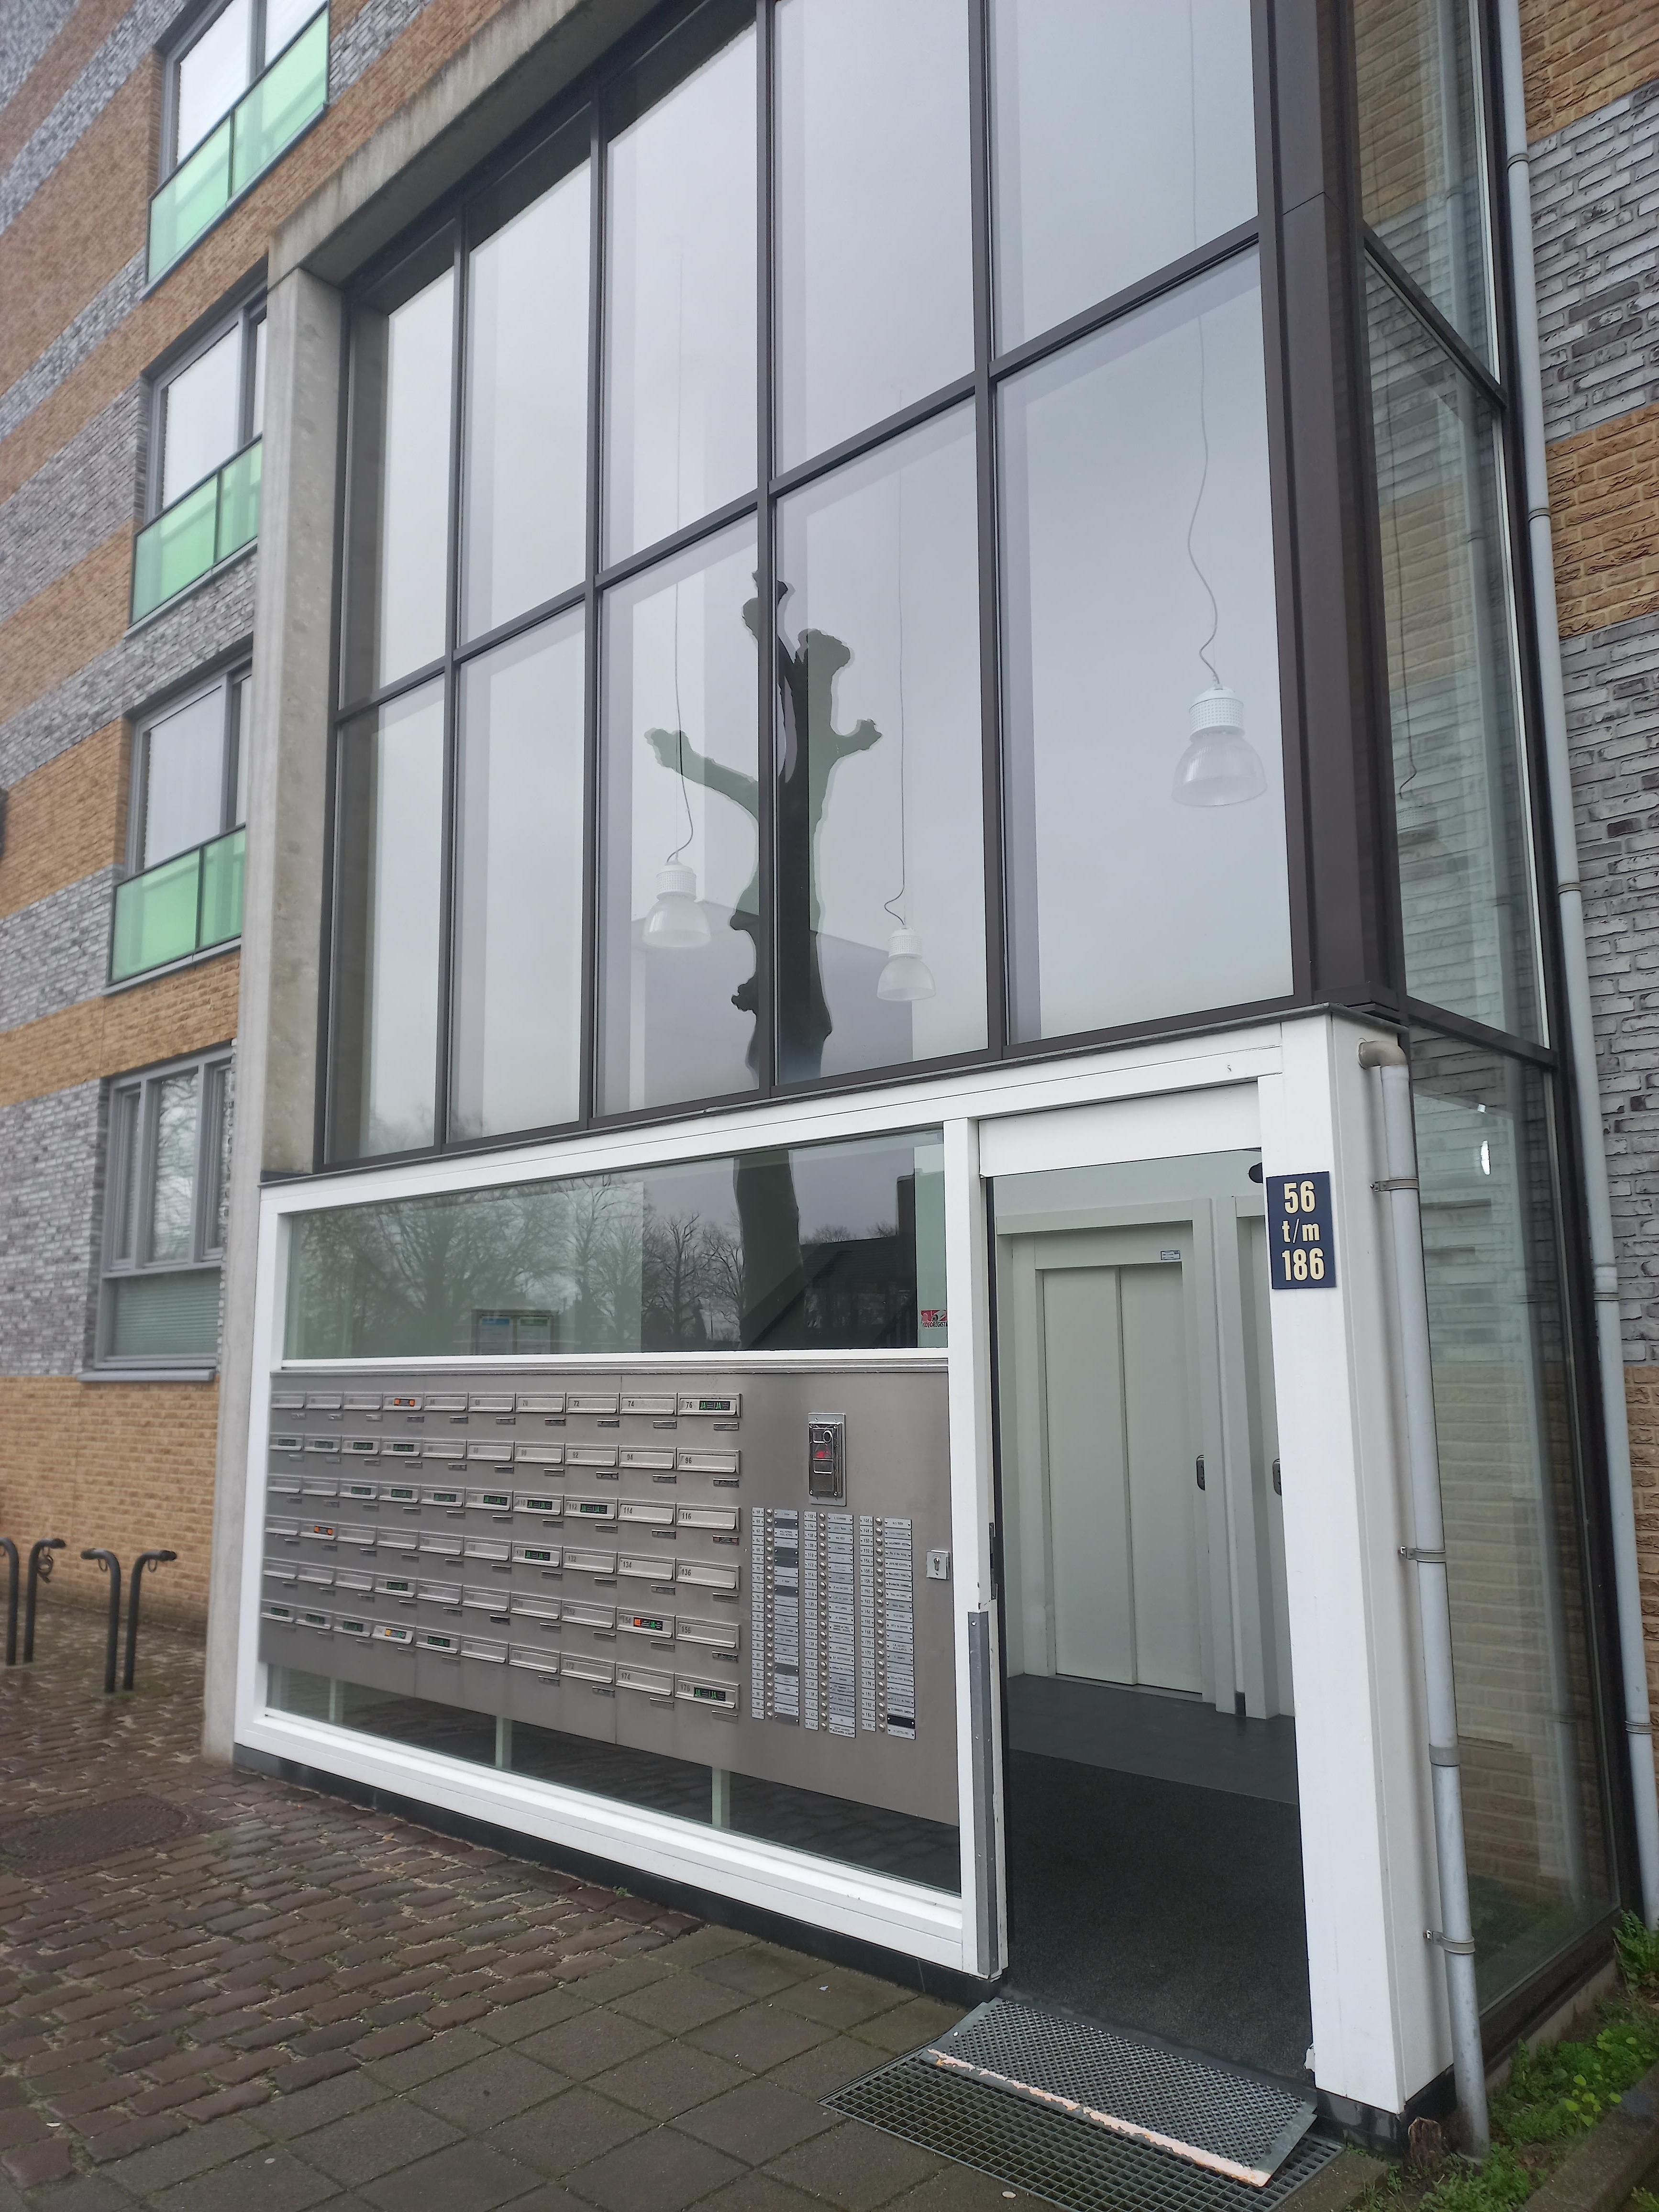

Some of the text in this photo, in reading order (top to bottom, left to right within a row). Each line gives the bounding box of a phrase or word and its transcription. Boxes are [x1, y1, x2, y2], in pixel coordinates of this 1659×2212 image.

[1283, 1181, 1316, 1214] 56
[1282, 1218, 1320, 1243] t/m
[1282, 1248, 1325, 1281] 186
